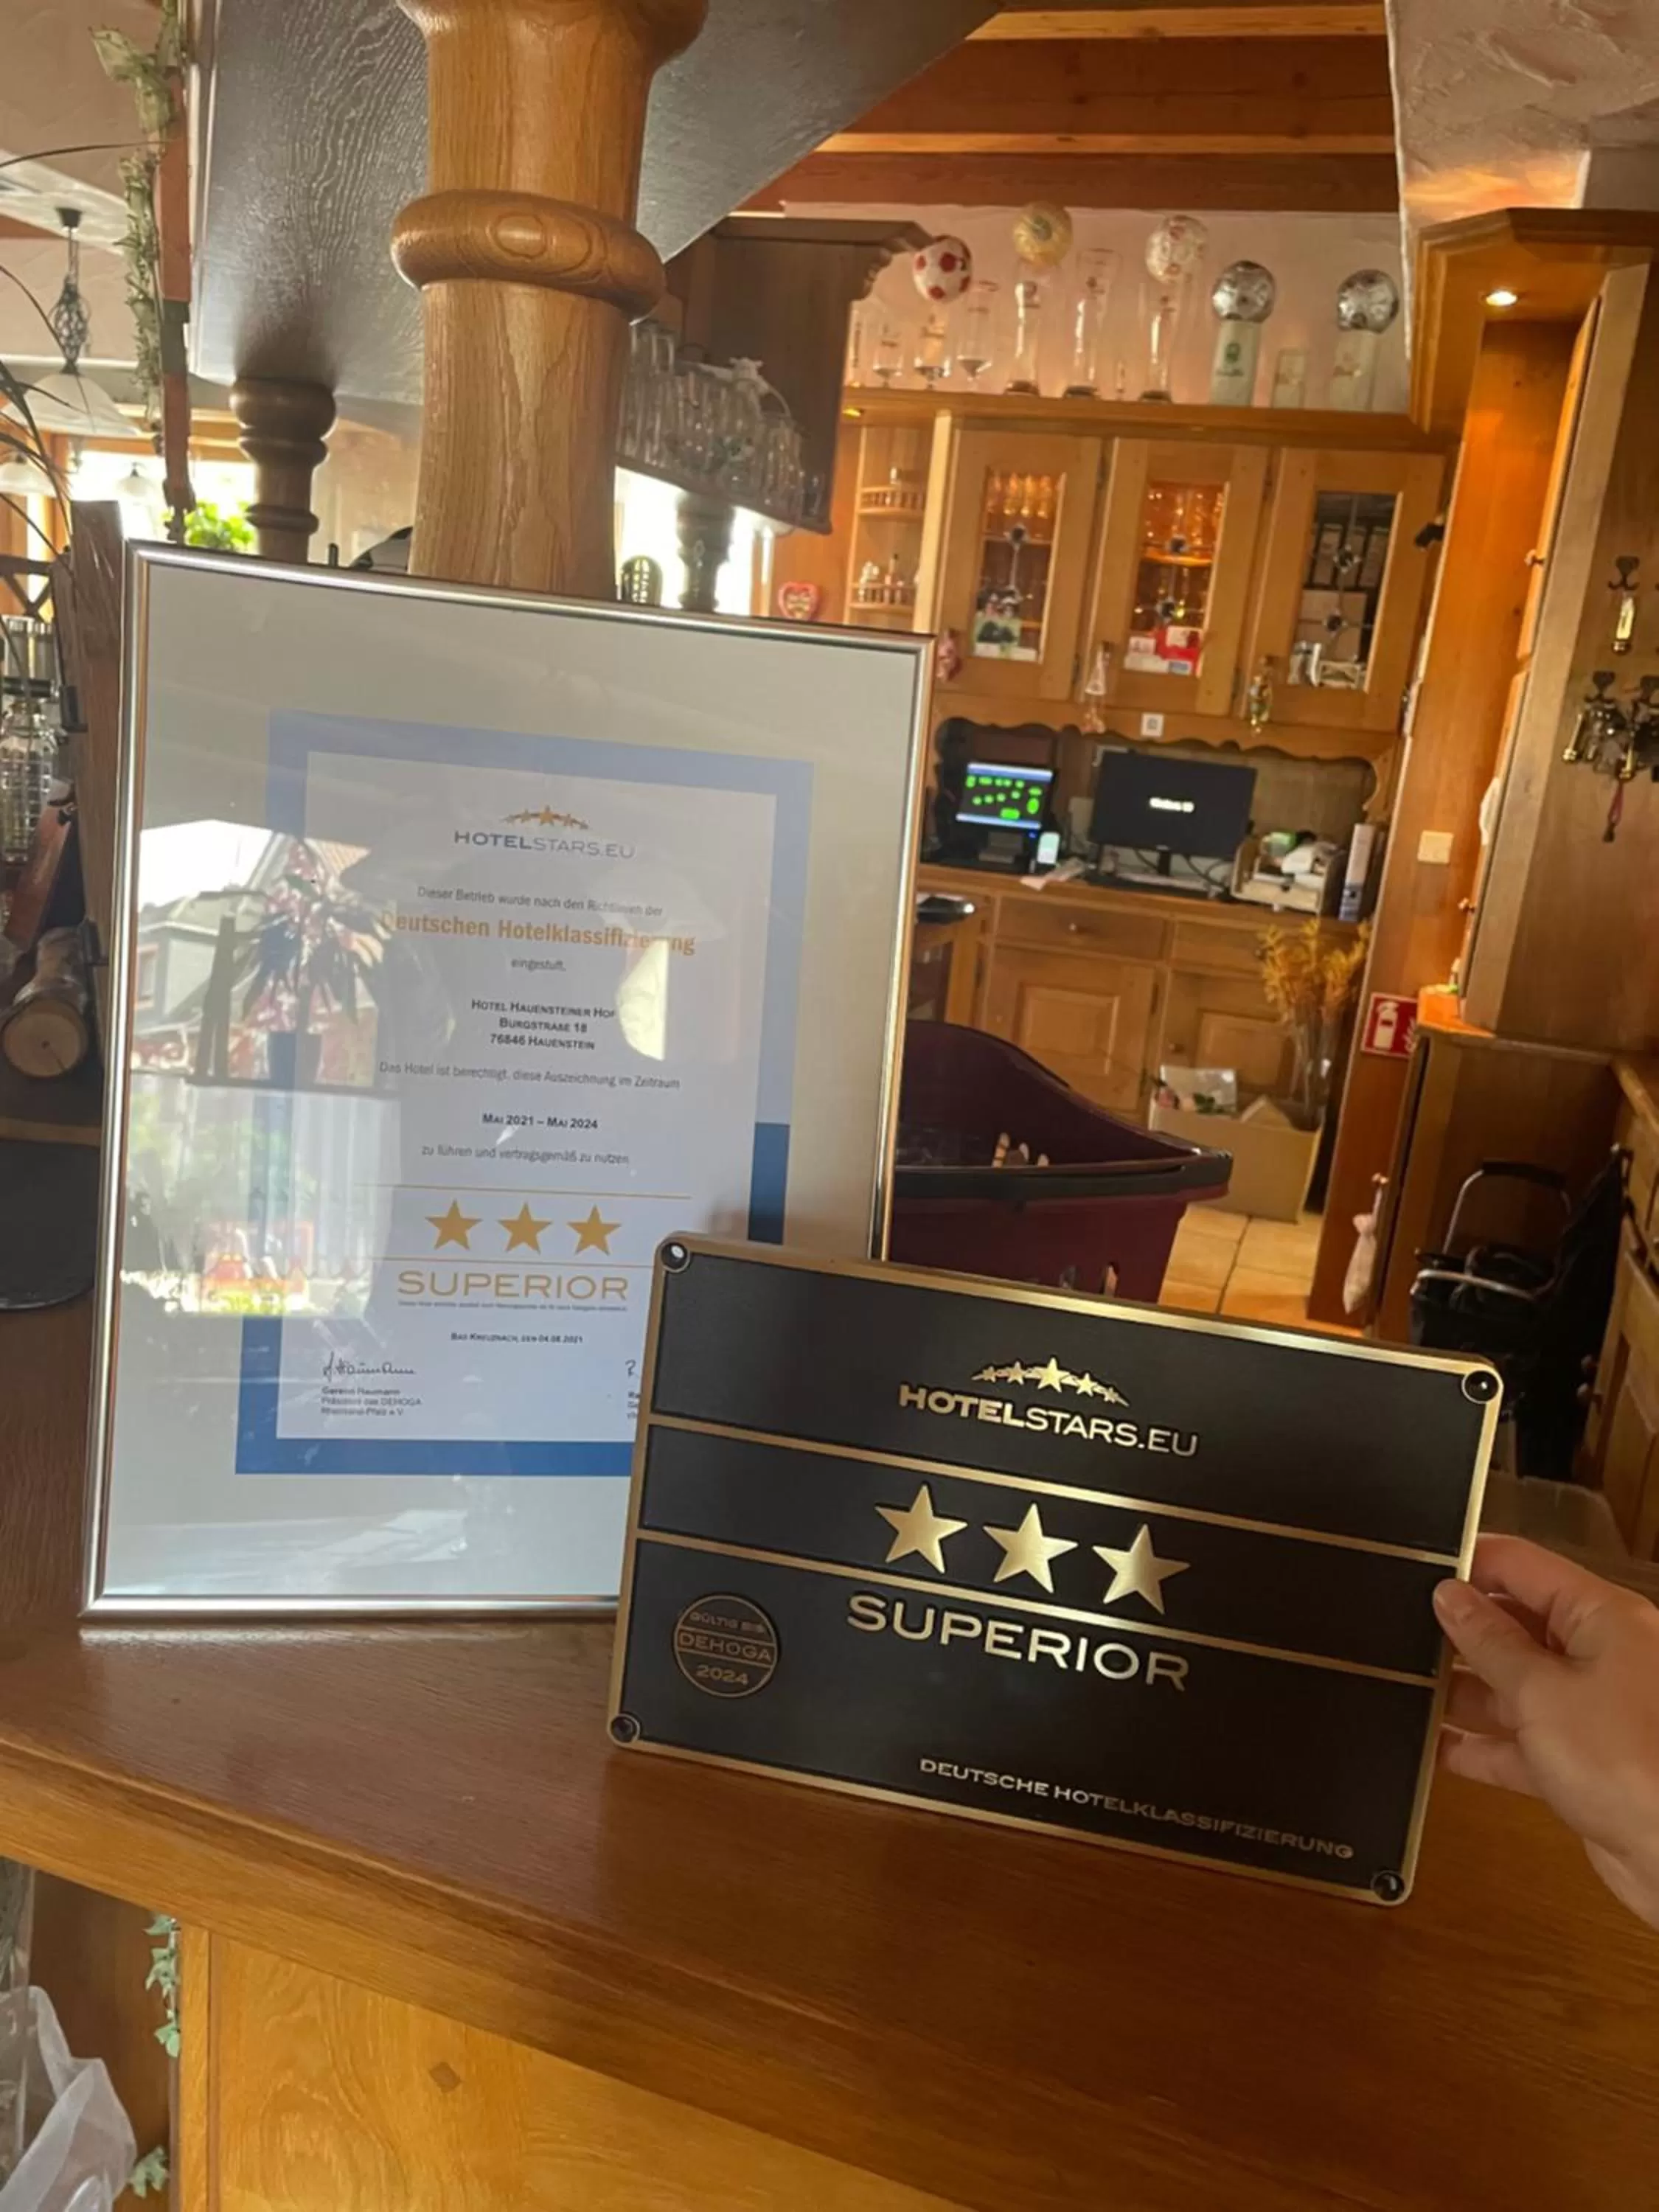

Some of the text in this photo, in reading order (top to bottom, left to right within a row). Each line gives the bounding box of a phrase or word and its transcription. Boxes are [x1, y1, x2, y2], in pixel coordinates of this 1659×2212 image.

[453, 830, 636, 859] HOTELSTARS.EU
[417, 886, 453, 900] Dieser
[456, 888, 495, 903] Betrieb
[498, 895, 531, 906] wurde
[534, 897, 561, 909] nach
[563, 899, 584, 909] den
[471, 998, 507, 1012] HOTEL
[510, 1001, 591, 1018] HAUENSTEINER
[528, 1036, 595, 1051] HAUENSTEIN
[380, 1062, 401, 1074] Das
[405, 1062, 434, 1075] Hotel
[437, 1065, 451, 1076] ist
[513, 1069, 542, 1082] diese
[543, 1071, 616, 1088] Auszeichnung
[619, 1077, 632, 1086] im
[634, 1075, 681, 1089] Zeitraum
[507, 1115, 534, 1127] 2021
[570, 1118, 598, 1129] 2024
[422, 1146, 434, 1156] zu
[437, 1144, 473, 1157] führen
[475, 1147, 496, 1158] und
[579, 1152, 591, 1163] zu
[397, 1270, 629, 1300] SUPERIOR
[898, 1383, 1198, 1457] HOTELSTARS.EU
[678, 1632, 772, 1662] DEHOGA
[846, 1594, 1190, 1693] SUPERIOR
[696, 1663, 748, 1686] 2024
[919, 1758, 1355, 1860] DEUTSCHE HOTELKLASSIFIZIERUNG
